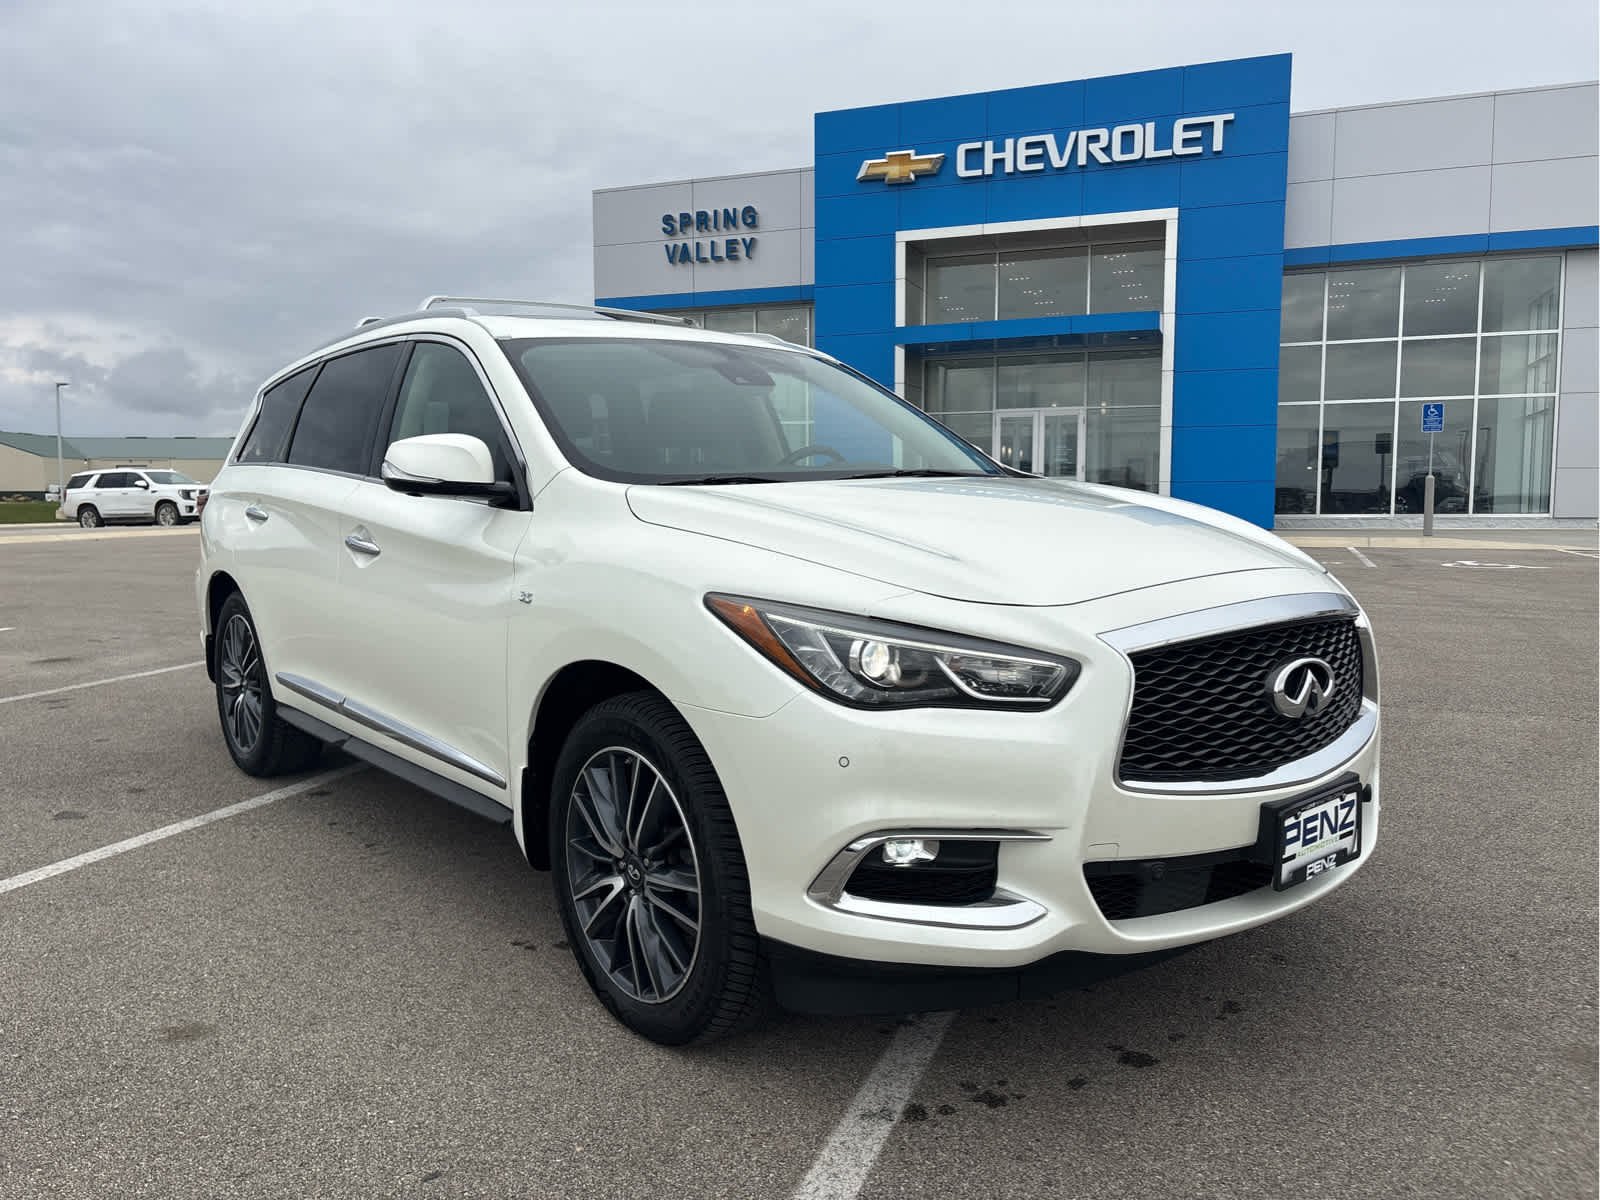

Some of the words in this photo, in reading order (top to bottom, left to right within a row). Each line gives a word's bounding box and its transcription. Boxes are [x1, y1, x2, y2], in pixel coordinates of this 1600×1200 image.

[956, 112, 1235, 178] CHEVROLET
[662, 205, 758, 236] SPRING
[664, 237, 757, 265] VALLEY
[1283, 799, 1355, 848] PENZ
[1306, 853, 1337, 878] PENZ
